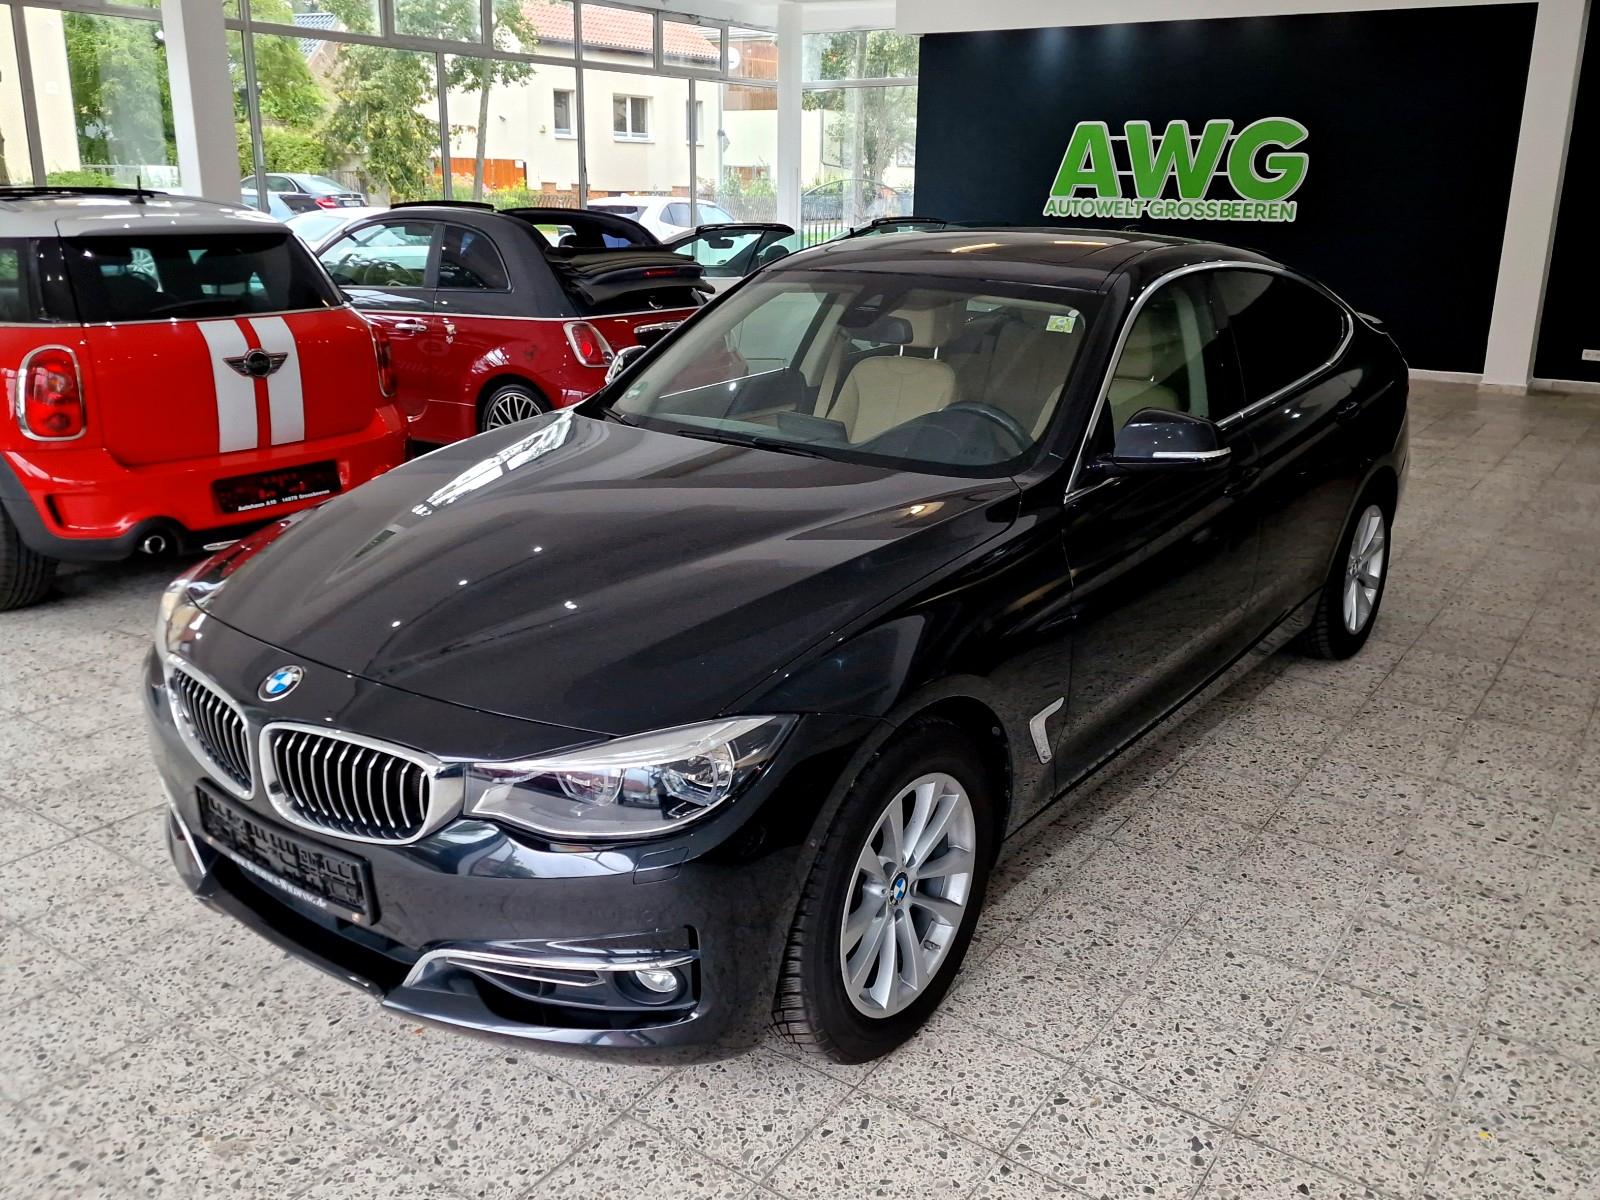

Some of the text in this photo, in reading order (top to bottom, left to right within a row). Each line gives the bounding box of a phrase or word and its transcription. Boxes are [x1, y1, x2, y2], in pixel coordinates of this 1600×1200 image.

[1049, 117, 1309, 202] AWG
[1043, 197, 1297, 222] AUTOWELT GROSSBEEREN
